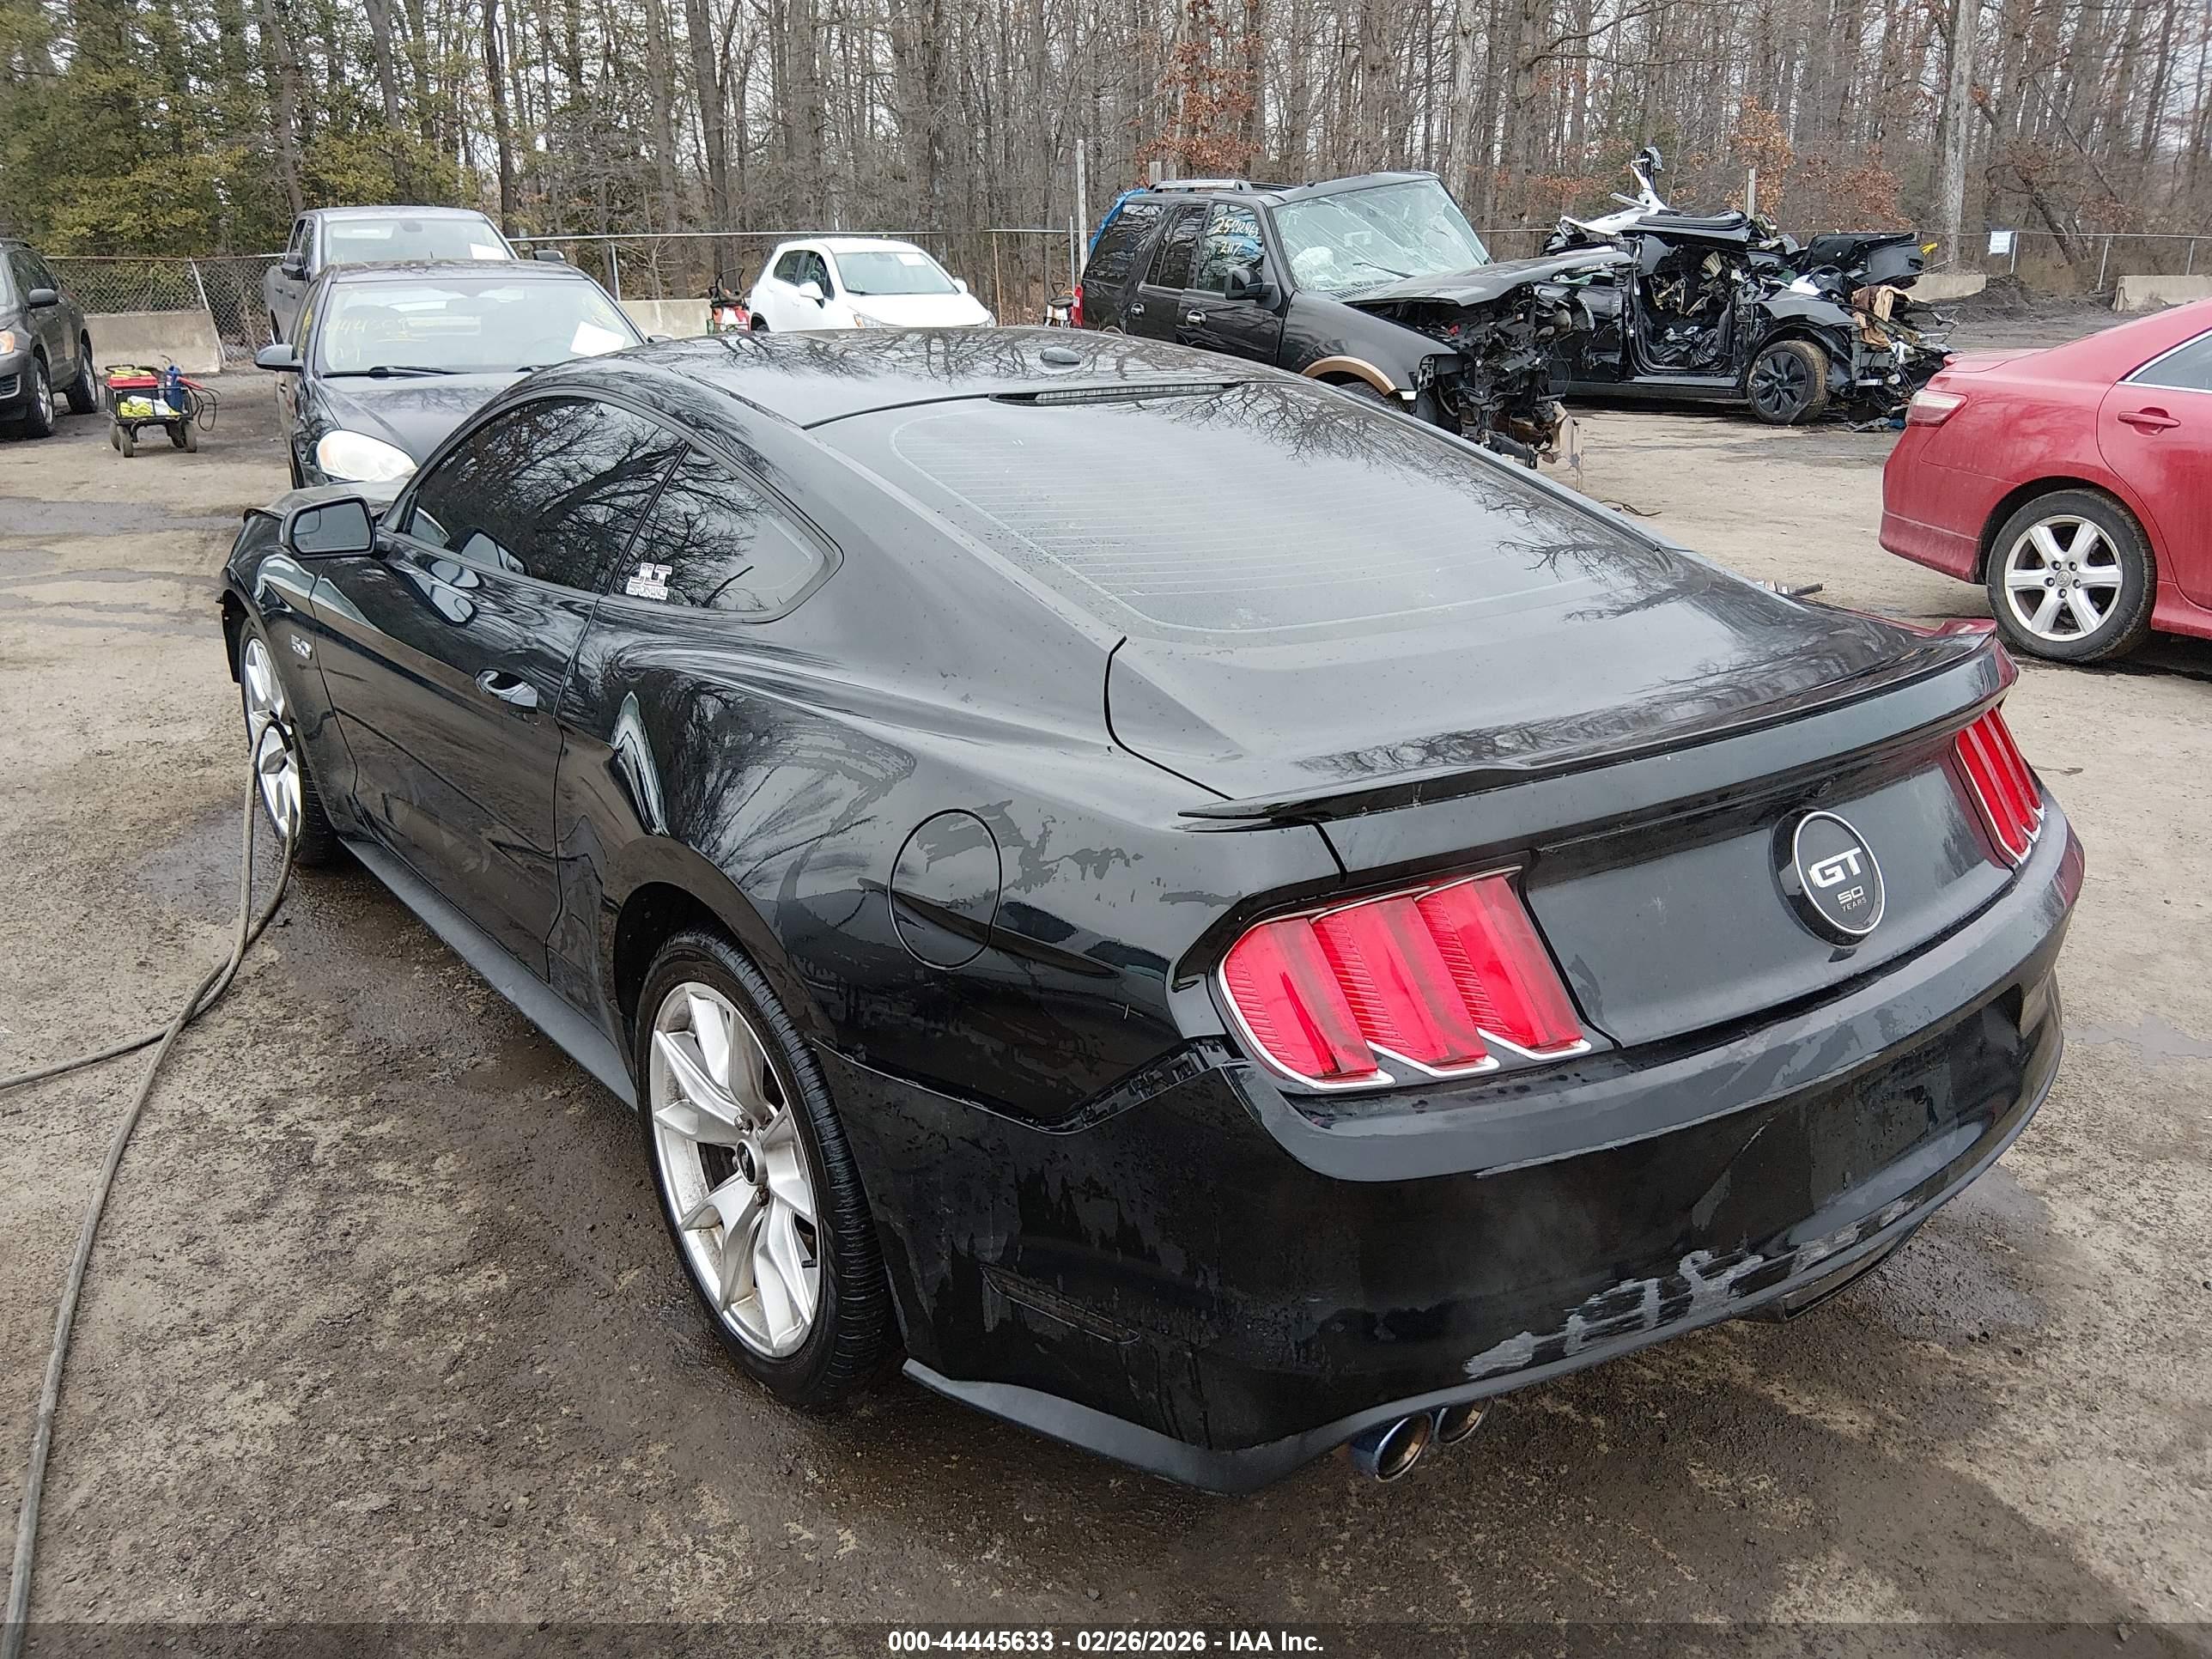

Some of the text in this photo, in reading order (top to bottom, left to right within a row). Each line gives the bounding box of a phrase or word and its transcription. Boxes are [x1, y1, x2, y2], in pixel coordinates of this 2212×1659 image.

[1808, 846, 1863, 888] GT
[1838, 885, 1863, 904] 50
[1841, 896, 1867, 913] YEARS
